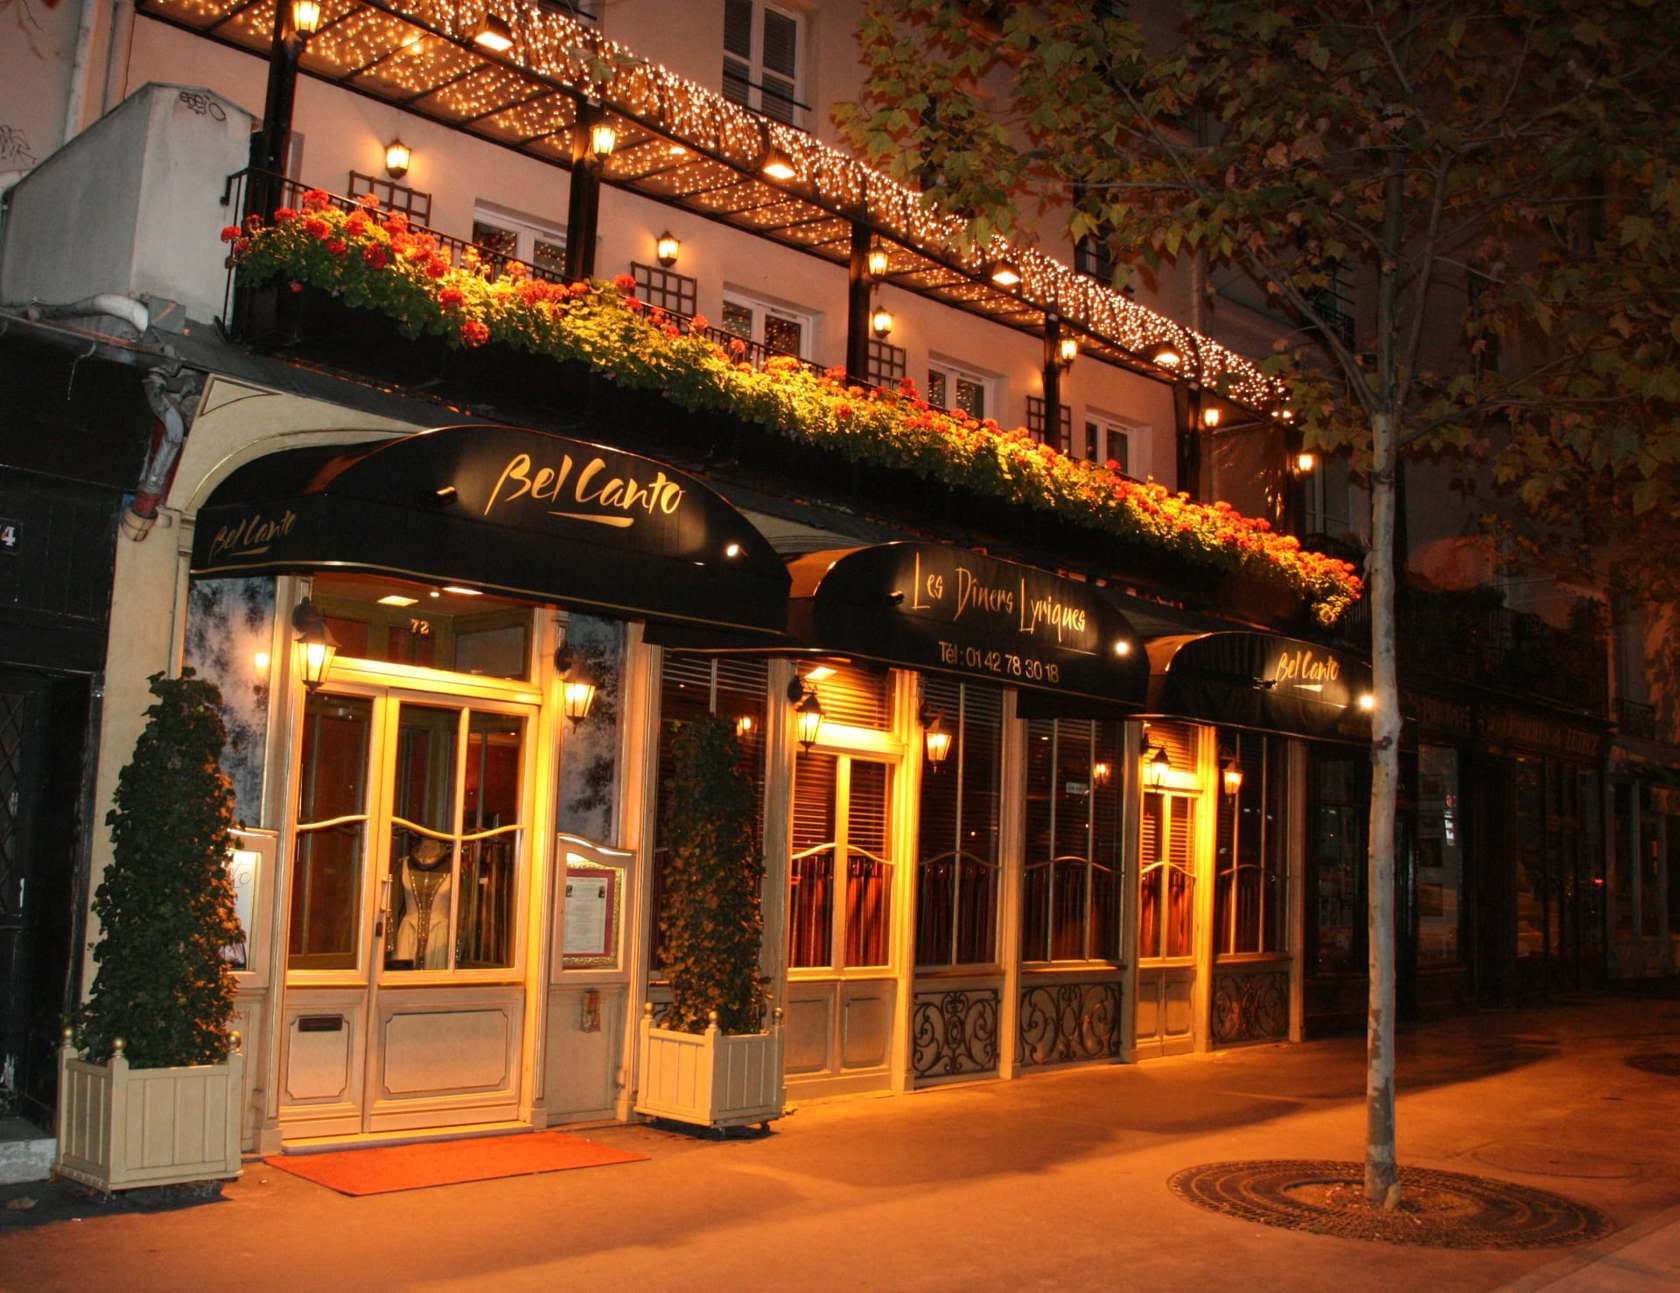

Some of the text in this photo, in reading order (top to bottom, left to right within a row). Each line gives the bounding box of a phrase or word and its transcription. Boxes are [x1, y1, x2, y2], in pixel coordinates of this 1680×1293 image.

[484, 453, 686, 515] Bel Canto
[0, 525, 16, 546] 4
[912, 552, 944, 610] Les
[1020, 578, 1086, 643] Lyriques
[410, 618, 430, 635] 72
[1276, 650, 1339, 681] Bel Canto
